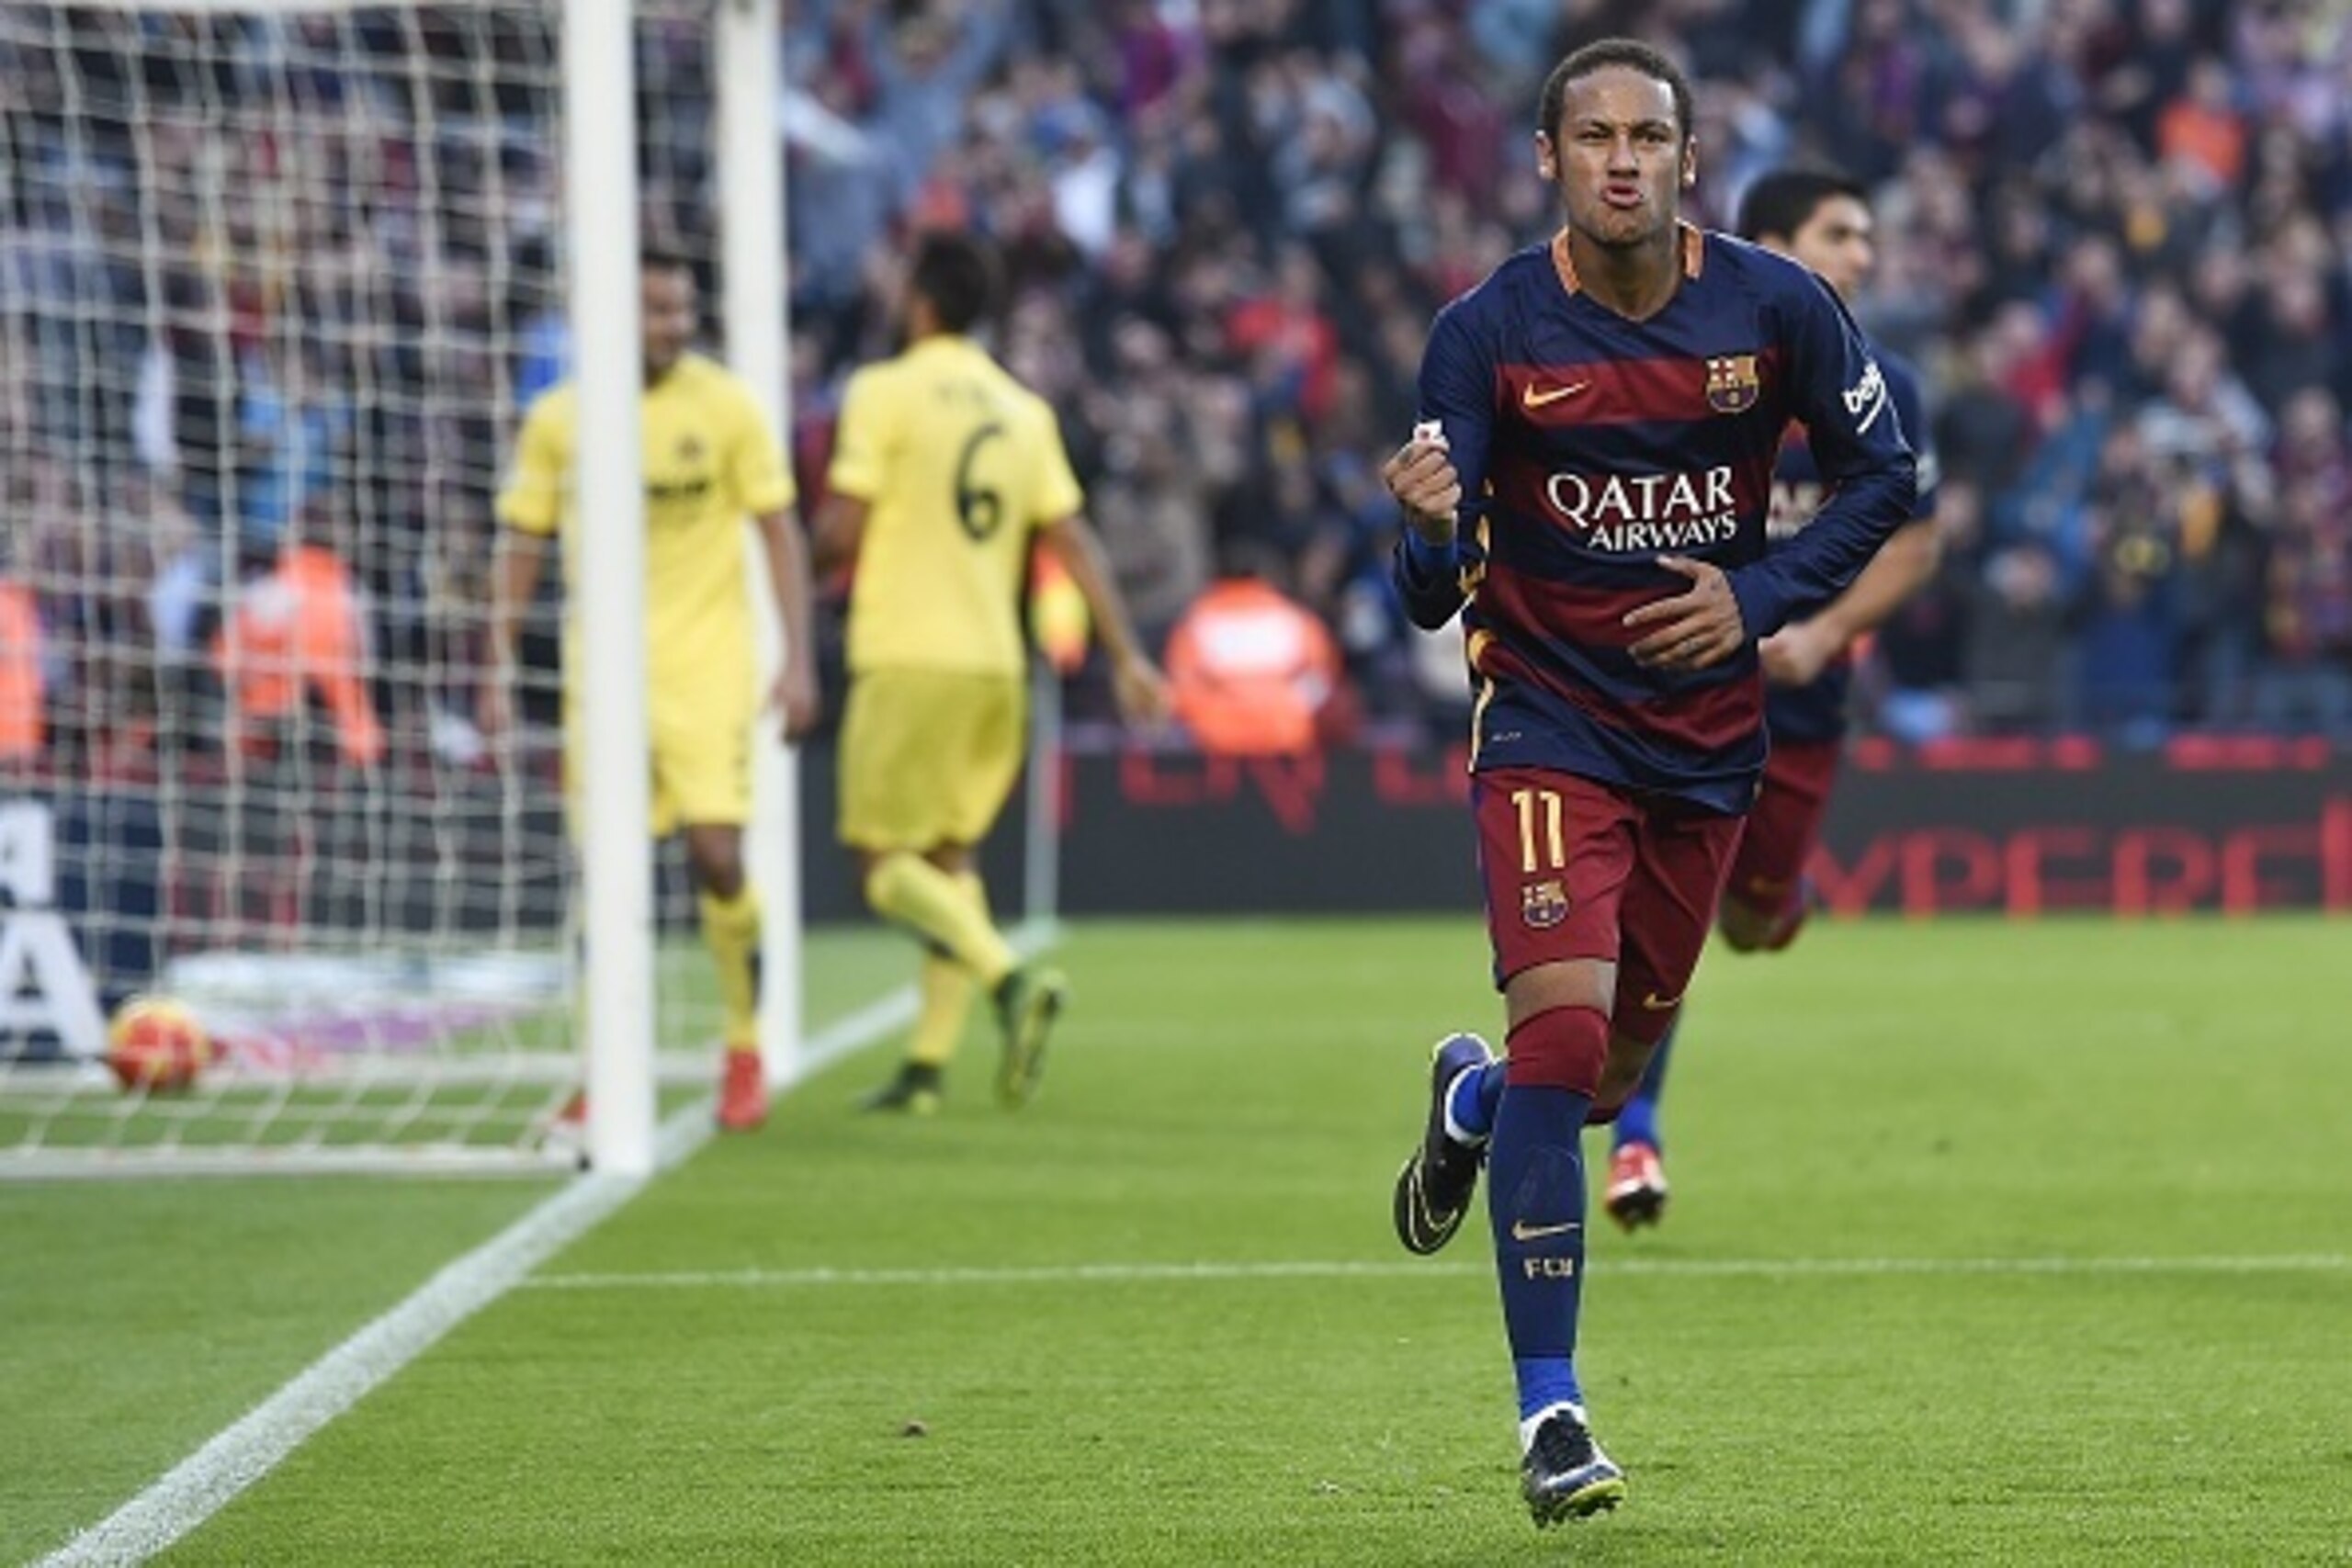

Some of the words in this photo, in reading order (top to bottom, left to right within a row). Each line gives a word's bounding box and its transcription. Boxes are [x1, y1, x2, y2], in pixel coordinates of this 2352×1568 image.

[950, 423, 1005, 544] 6
[1547, 466, 1736, 528] QATAR
[1588, 509, 1738, 551] AIRWAYS
[1511, 790, 1565, 872] 11
